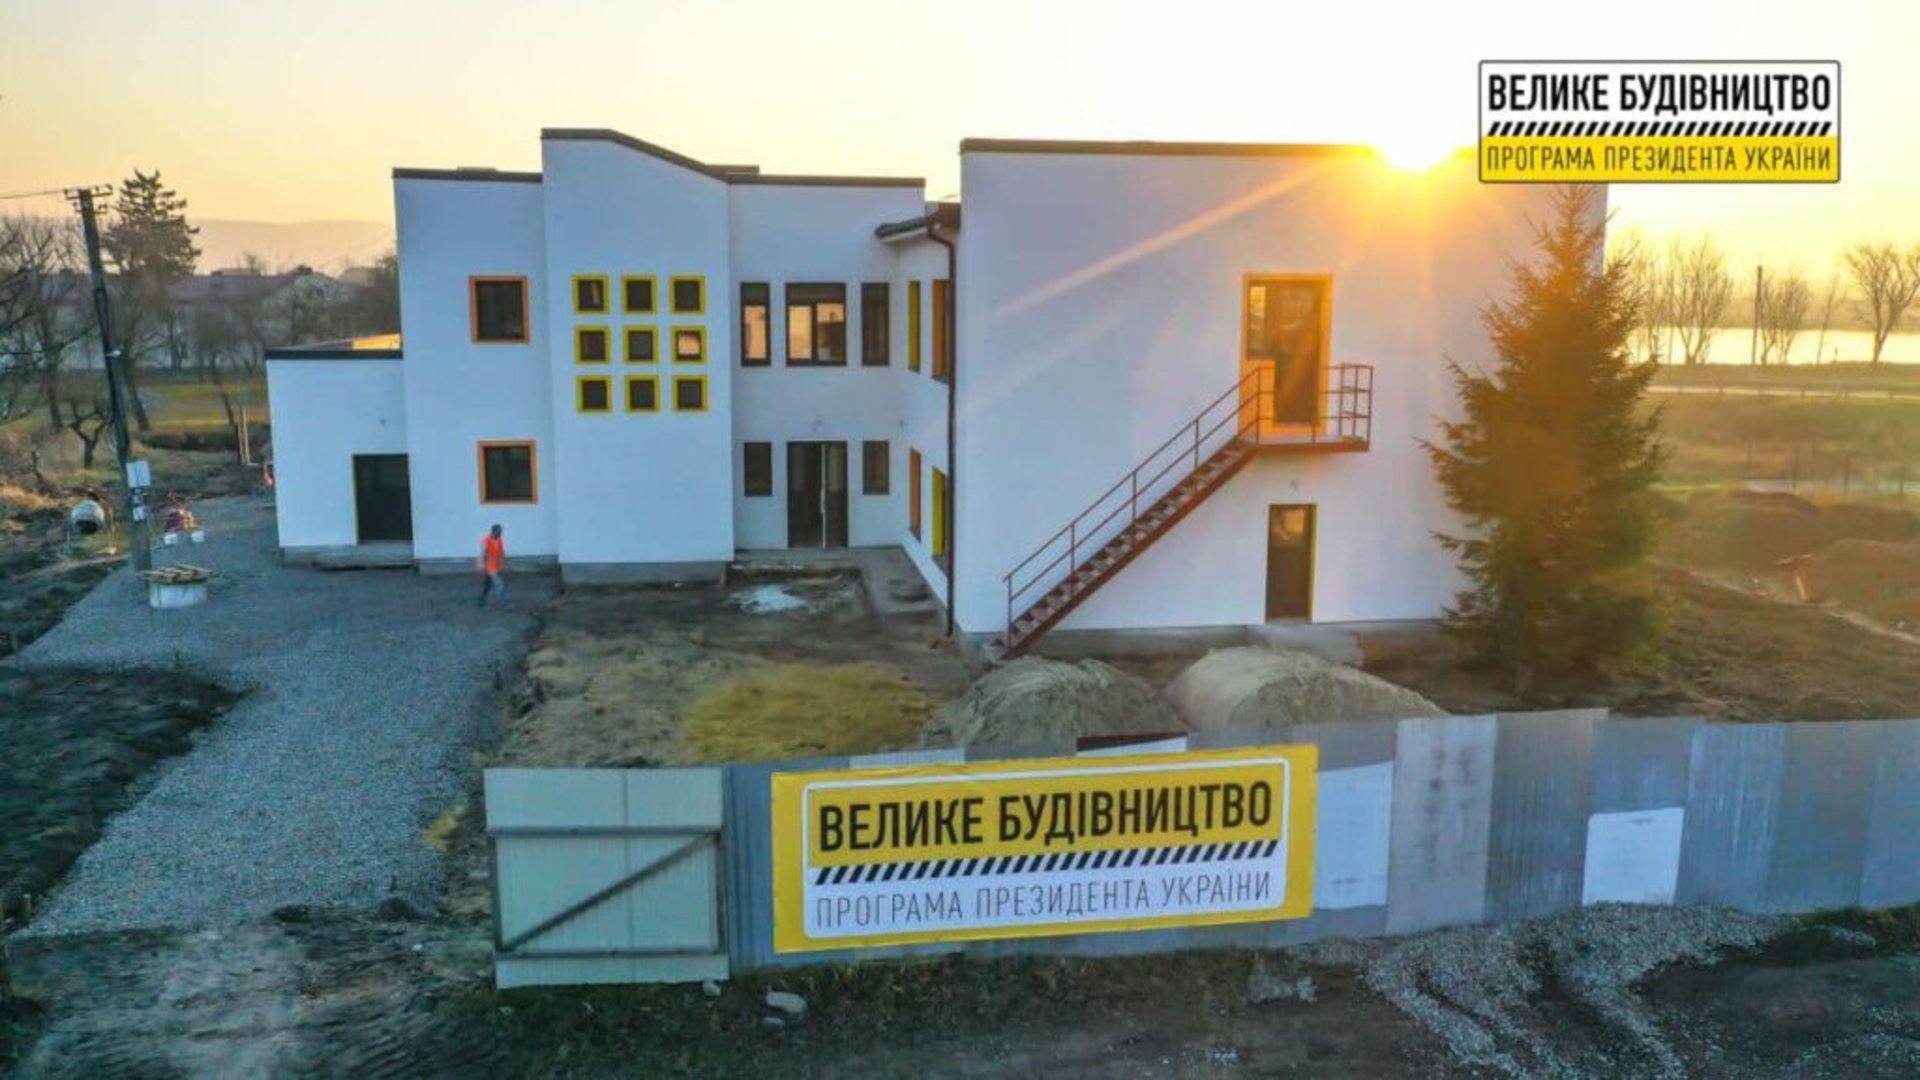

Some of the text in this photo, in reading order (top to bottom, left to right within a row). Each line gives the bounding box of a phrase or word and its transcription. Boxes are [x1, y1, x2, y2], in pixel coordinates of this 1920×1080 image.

[819, 780, 1272, 852] ВЕЛИКЕ БУДІВНИЦТВО
[817, 871, 1271, 928] ПРОГРАМА ПРЕЗИДЕНТА УКРАЇНИ
